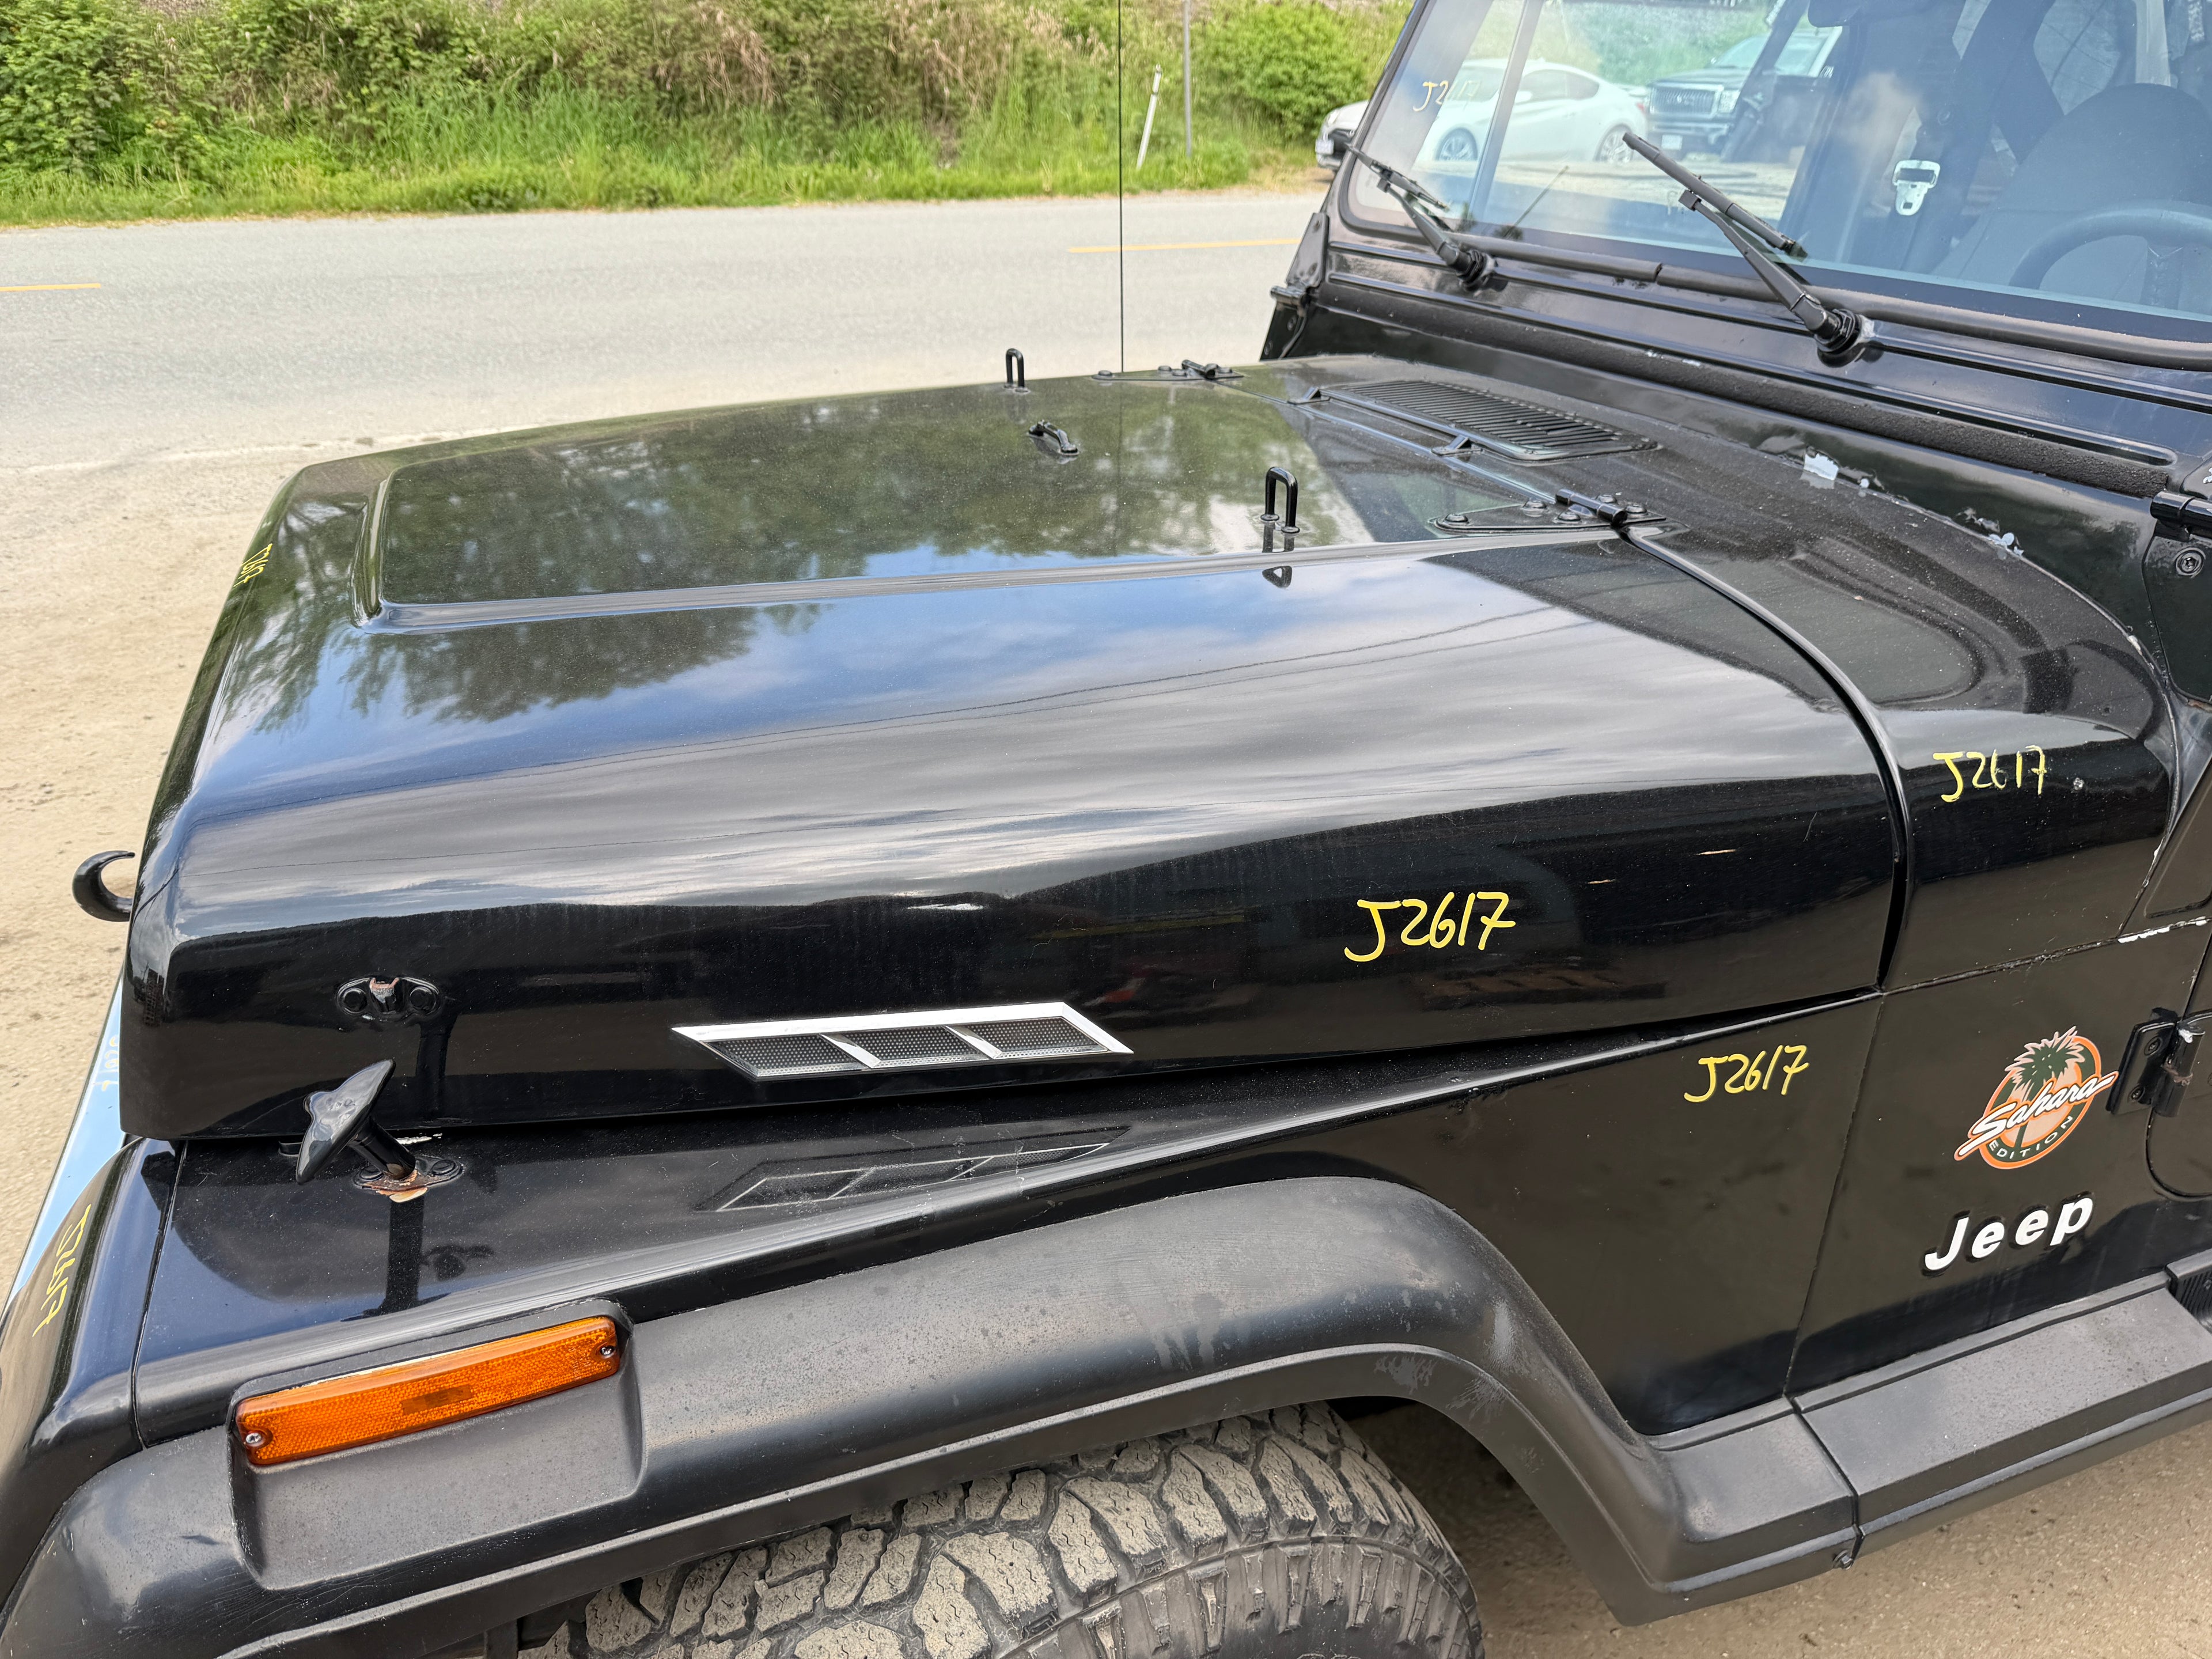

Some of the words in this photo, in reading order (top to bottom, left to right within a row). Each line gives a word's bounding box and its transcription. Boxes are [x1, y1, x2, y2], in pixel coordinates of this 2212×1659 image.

[1933, 745, 2047, 802] J2617
[1344, 891, 1516, 962] J2617
[1684, 1044, 1809, 1103] J2617
[1958, 1074, 2116, 1156] Sahara
[1989, 1116, 2073, 1159] EDITION
[1925, 1198, 2093, 1270] Jeep
[32, 1204, 92, 1337] J2617
